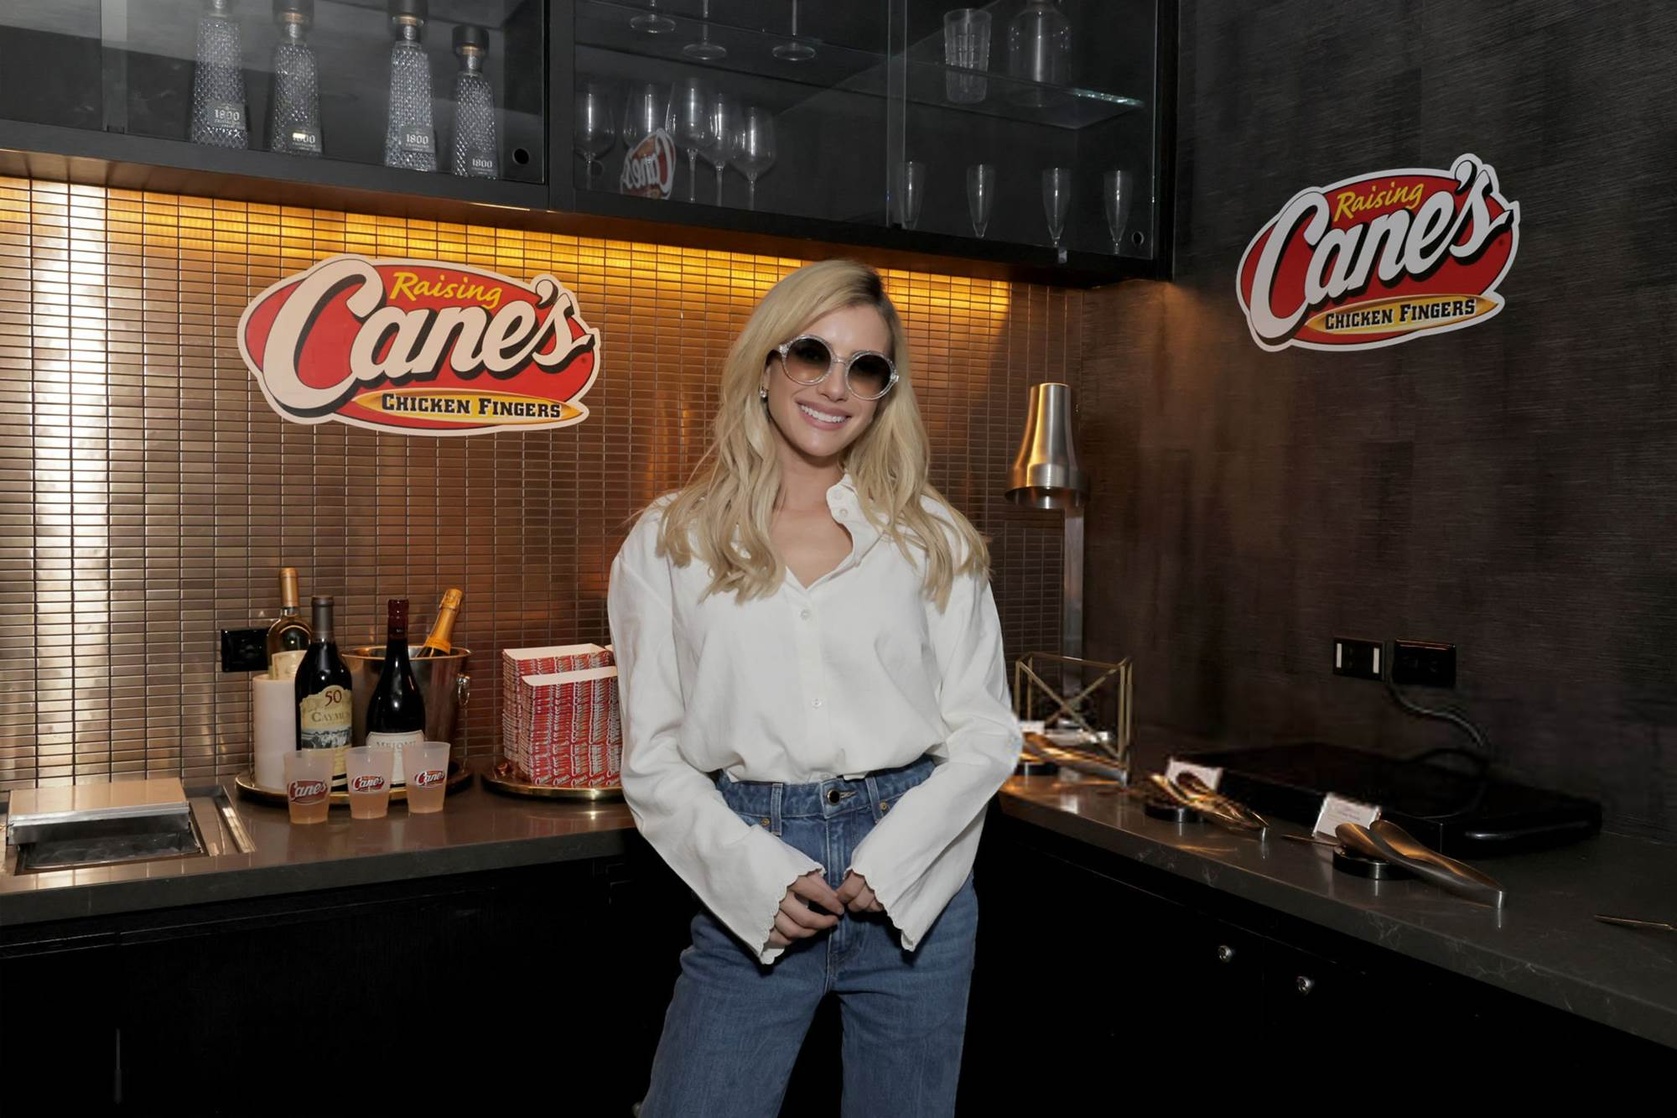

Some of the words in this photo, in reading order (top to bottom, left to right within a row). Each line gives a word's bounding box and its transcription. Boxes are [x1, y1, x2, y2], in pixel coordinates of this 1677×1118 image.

[214, 108, 240, 121] 1800
[406, 133, 429, 145] 1800
[472, 158, 493, 168] 1800
[1333, 182, 1425, 222] Raising
[1250, 160, 1512, 340] Cane's
[389, 272, 503, 310] Raising
[1325, 308, 1393, 331] CHICKEN
[1399, 299, 1476, 322] FINGERS
[262, 258, 594, 414] Cane's
[381, 393, 471, 415] CHICKEN
[478, 398, 561, 419] FINGERS
[325, 689, 342, 707] 50
